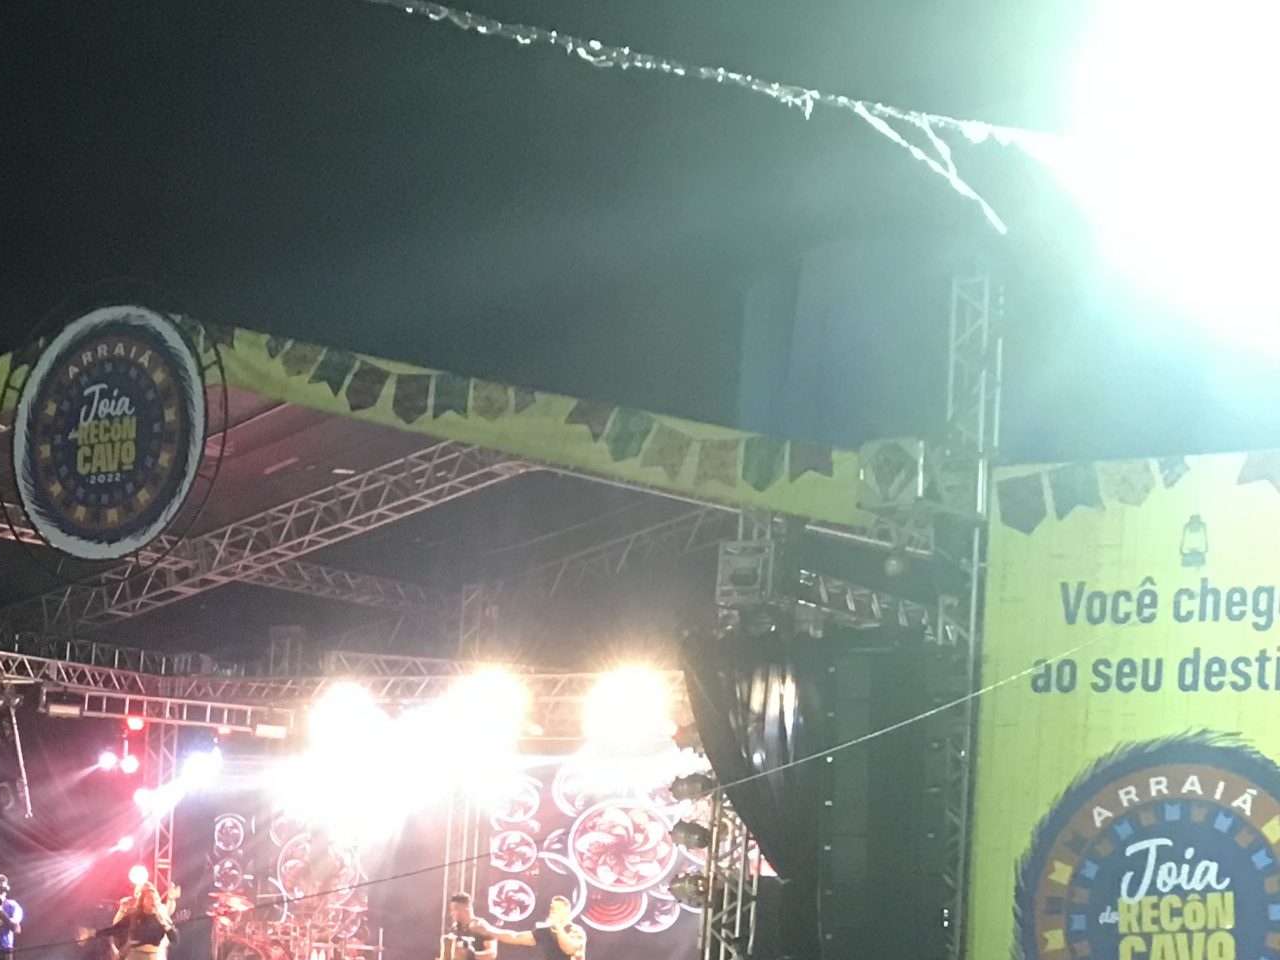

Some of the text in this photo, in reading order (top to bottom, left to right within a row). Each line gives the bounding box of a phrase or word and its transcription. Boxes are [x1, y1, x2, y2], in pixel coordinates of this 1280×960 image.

[81, 383, 135, 424] Joia
[1060, 576, 1280, 632] Você cheg
[1031, 658, 1077, 694] ao
[1090, 657, 1163, 693] seu
[1121, 837, 1231, 904] Joia
[1118, 891, 1235, 934] RECÔN
